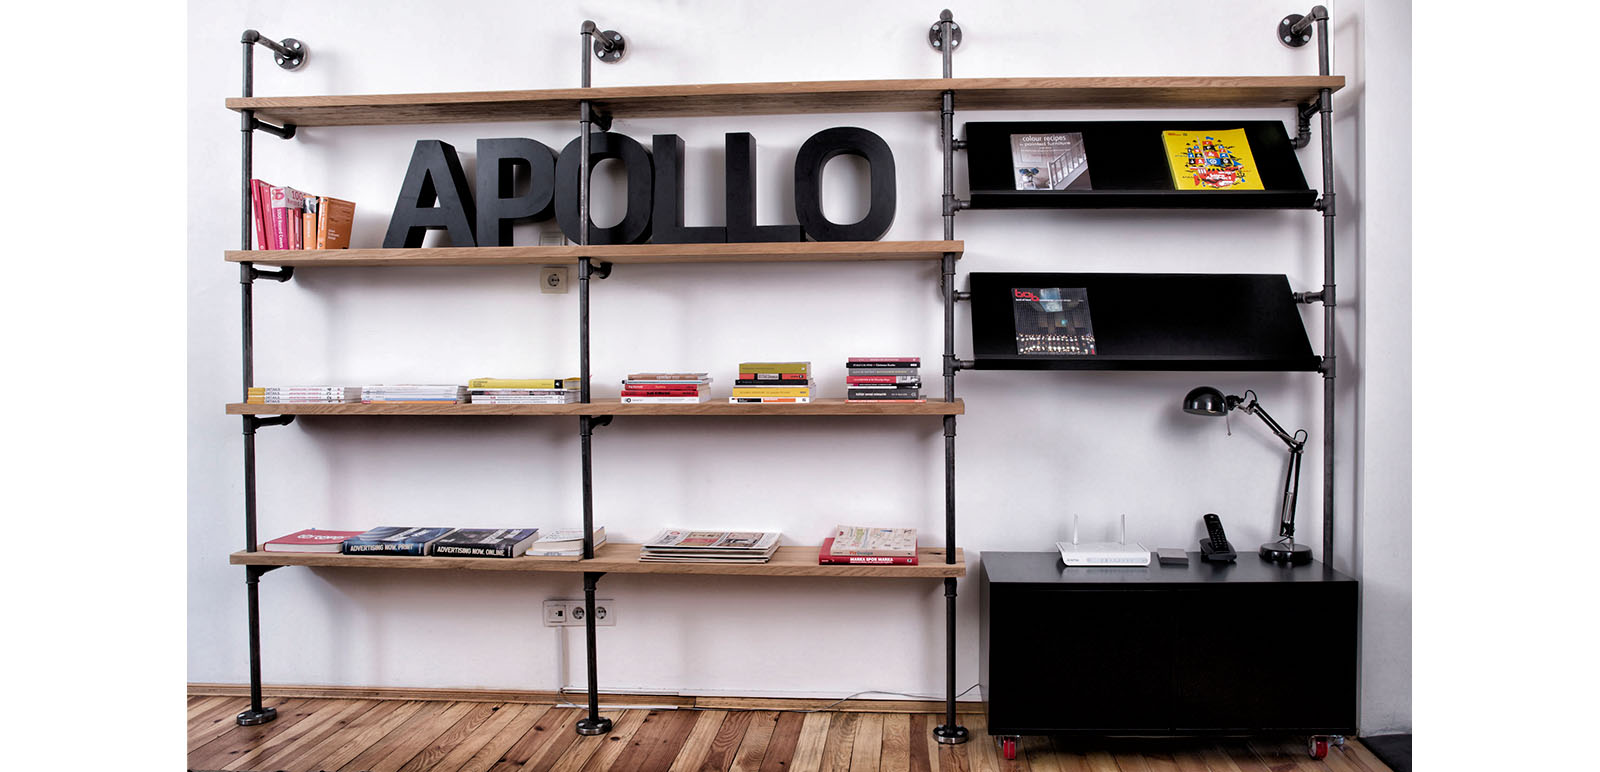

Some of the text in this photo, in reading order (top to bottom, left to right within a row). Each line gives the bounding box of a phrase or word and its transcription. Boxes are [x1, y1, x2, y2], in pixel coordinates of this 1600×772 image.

[383, 126, 897, 248] APOLLO
[350, 544, 384, 552] ADVERTISING
[437, 546, 471, 554] ADVERTISING
[485, 549, 505, 557] ONLINE
